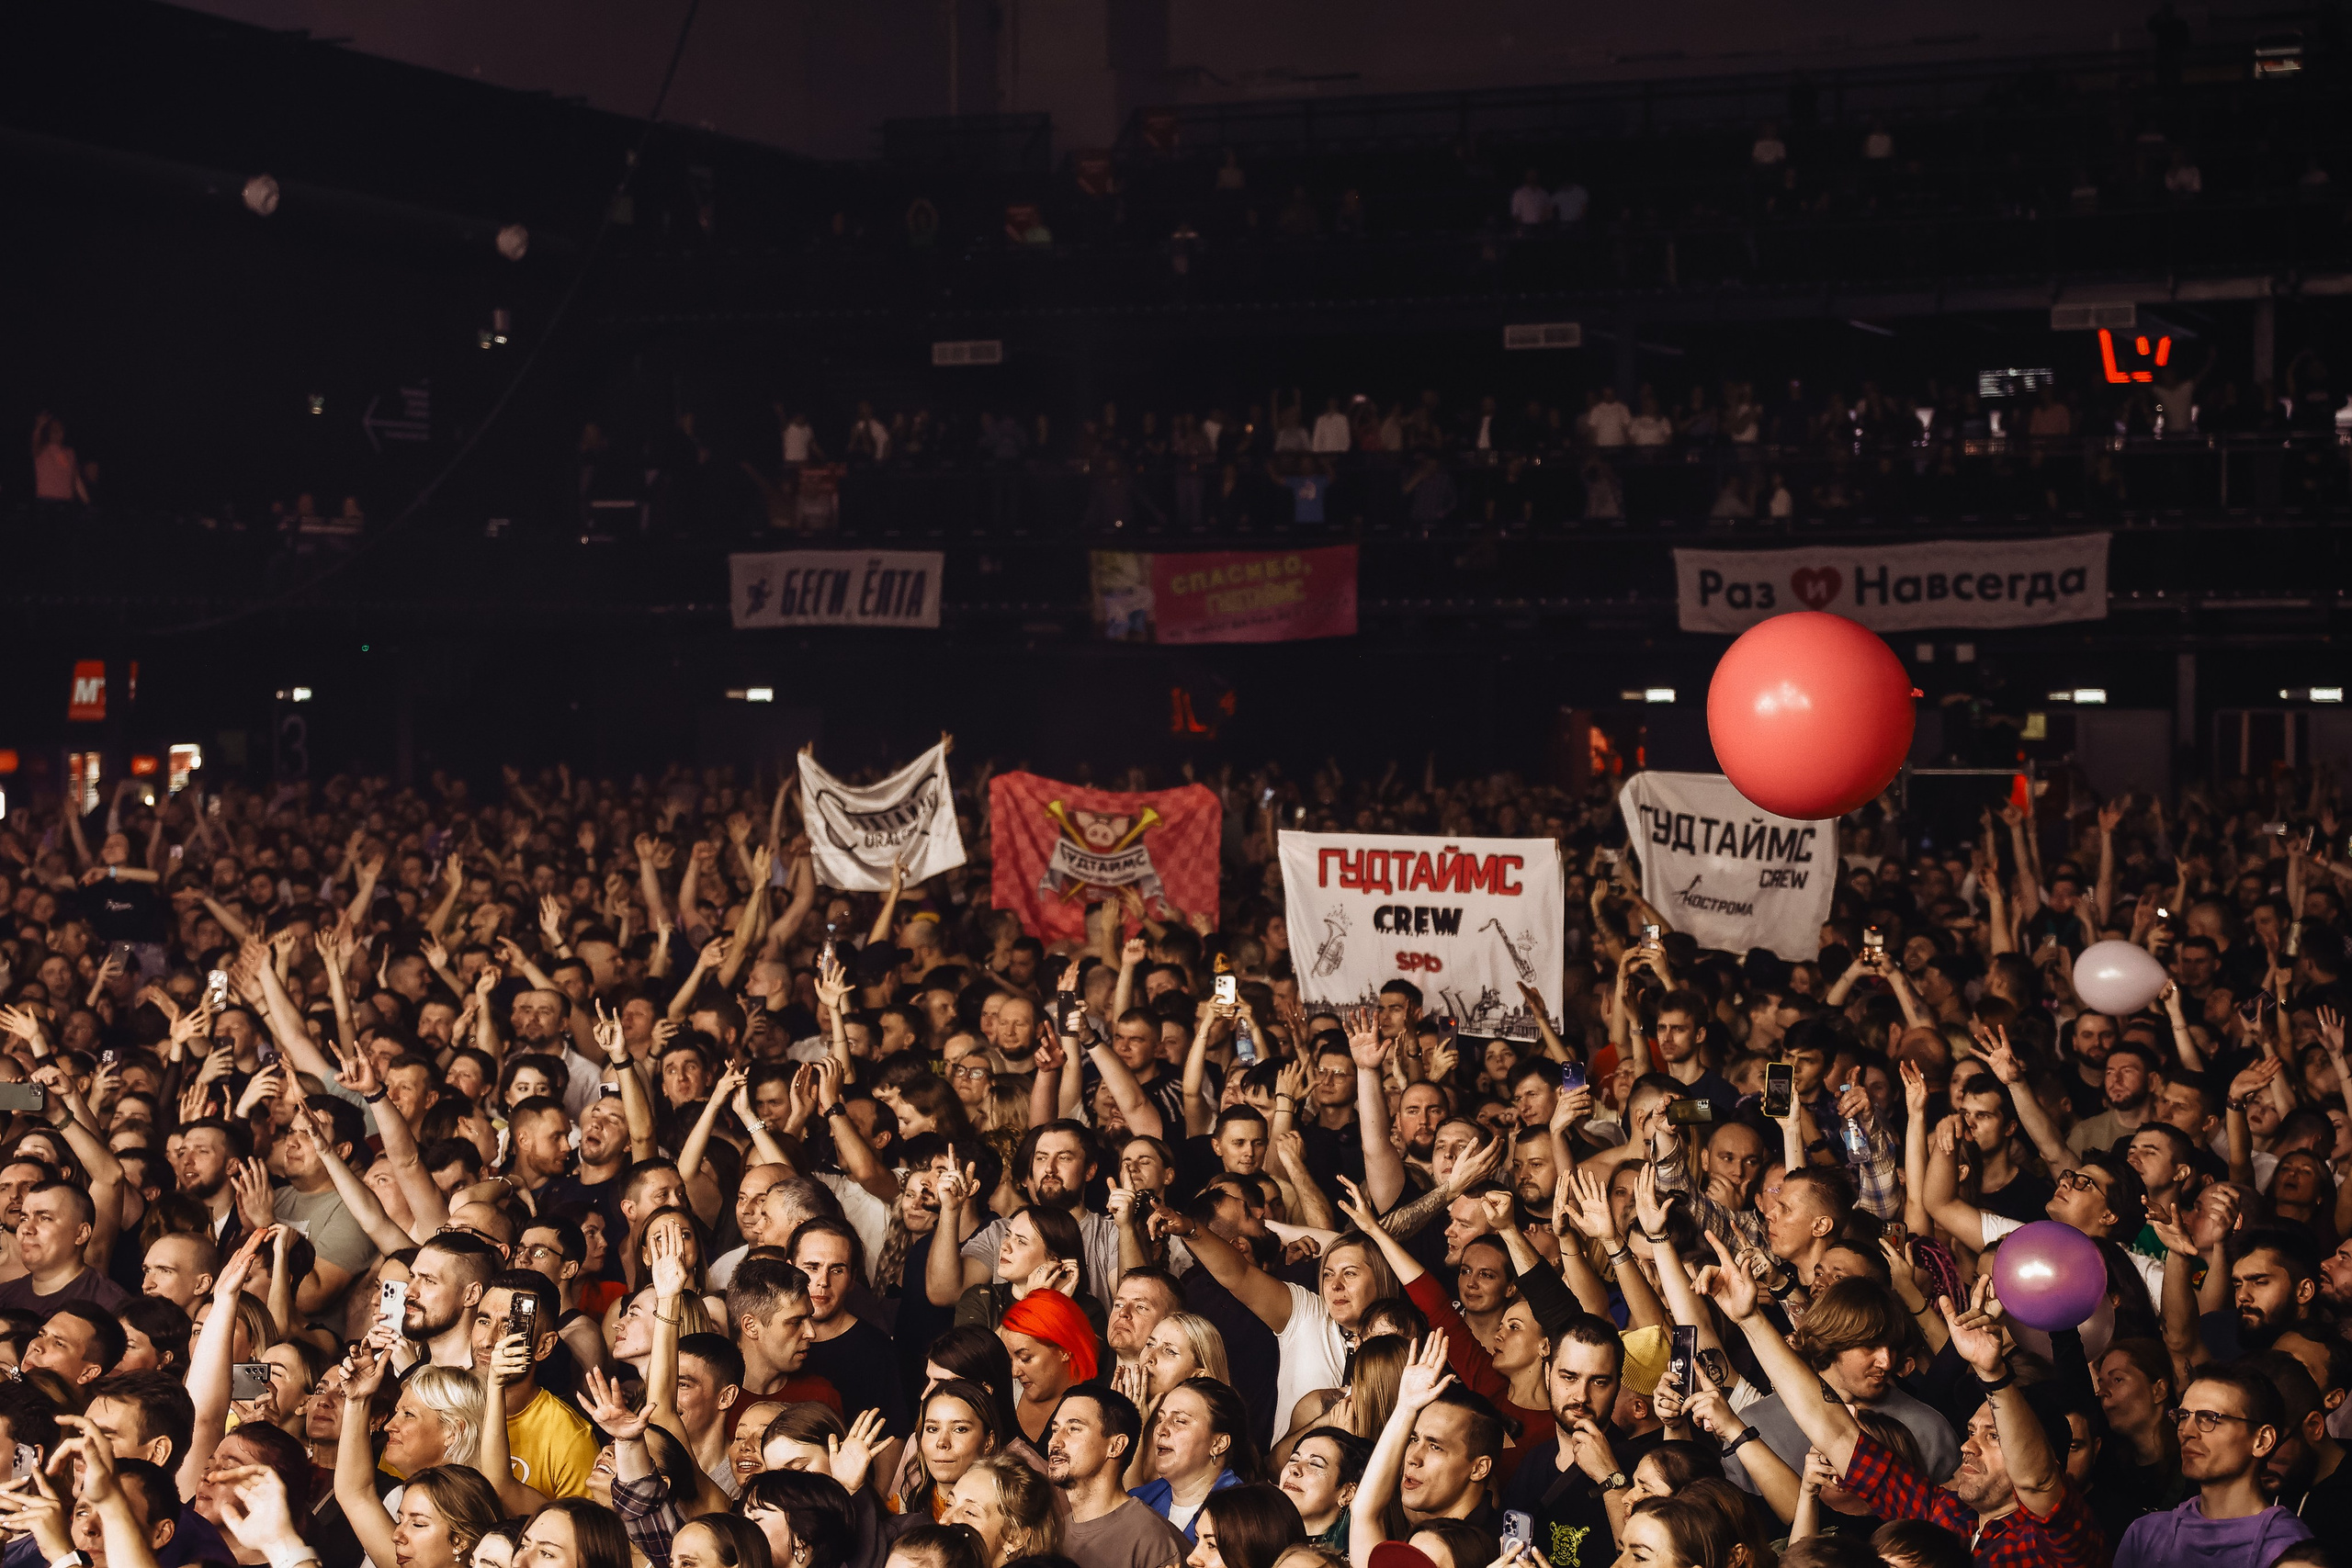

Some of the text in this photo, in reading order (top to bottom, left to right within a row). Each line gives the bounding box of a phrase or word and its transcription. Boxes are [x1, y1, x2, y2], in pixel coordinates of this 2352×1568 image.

[1698, 568, 1776, 609] Раз
[1854, 565, 2087, 606] Навсегда
[1640, 804, 1816, 863] ГУДТАЙМС
[1318, 845, 1523, 896] ГУДТАЙМС
[1759, 869, 1808, 889] CREW
[1373, 905, 1464, 937] CREW
[1680, 890, 1753, 916] КОСТРОМА
